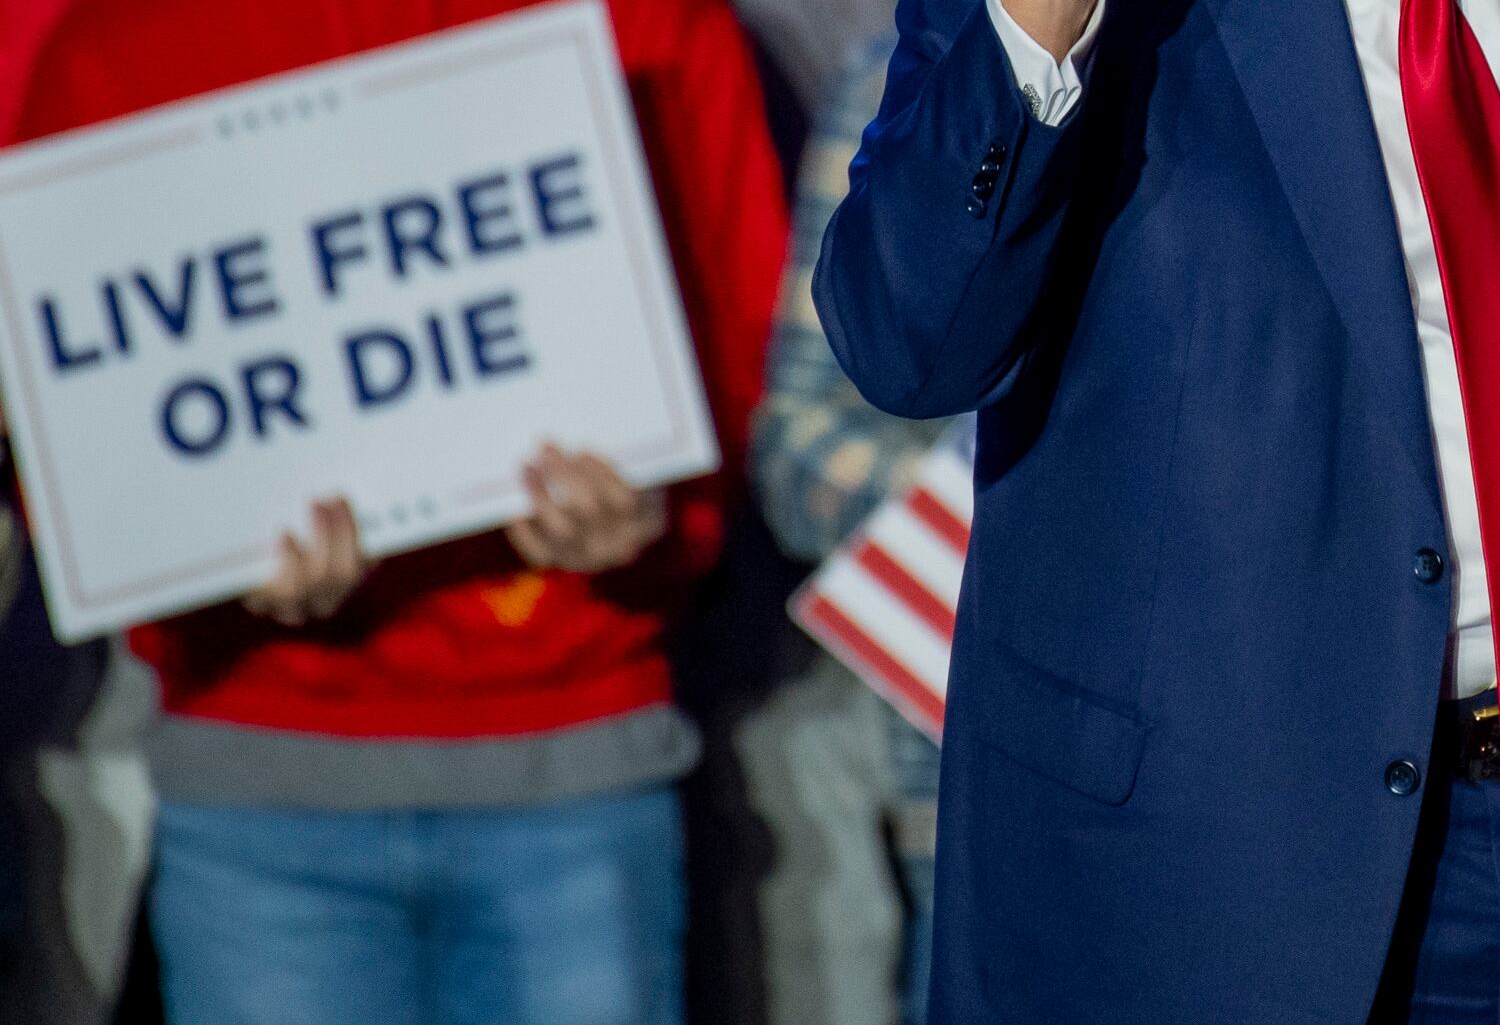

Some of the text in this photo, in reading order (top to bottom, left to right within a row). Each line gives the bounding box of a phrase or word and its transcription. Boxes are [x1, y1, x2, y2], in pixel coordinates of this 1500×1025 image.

[36, 151, 597, 373] LIVE FREE
[156, 292, 535, 457] OR DIE
